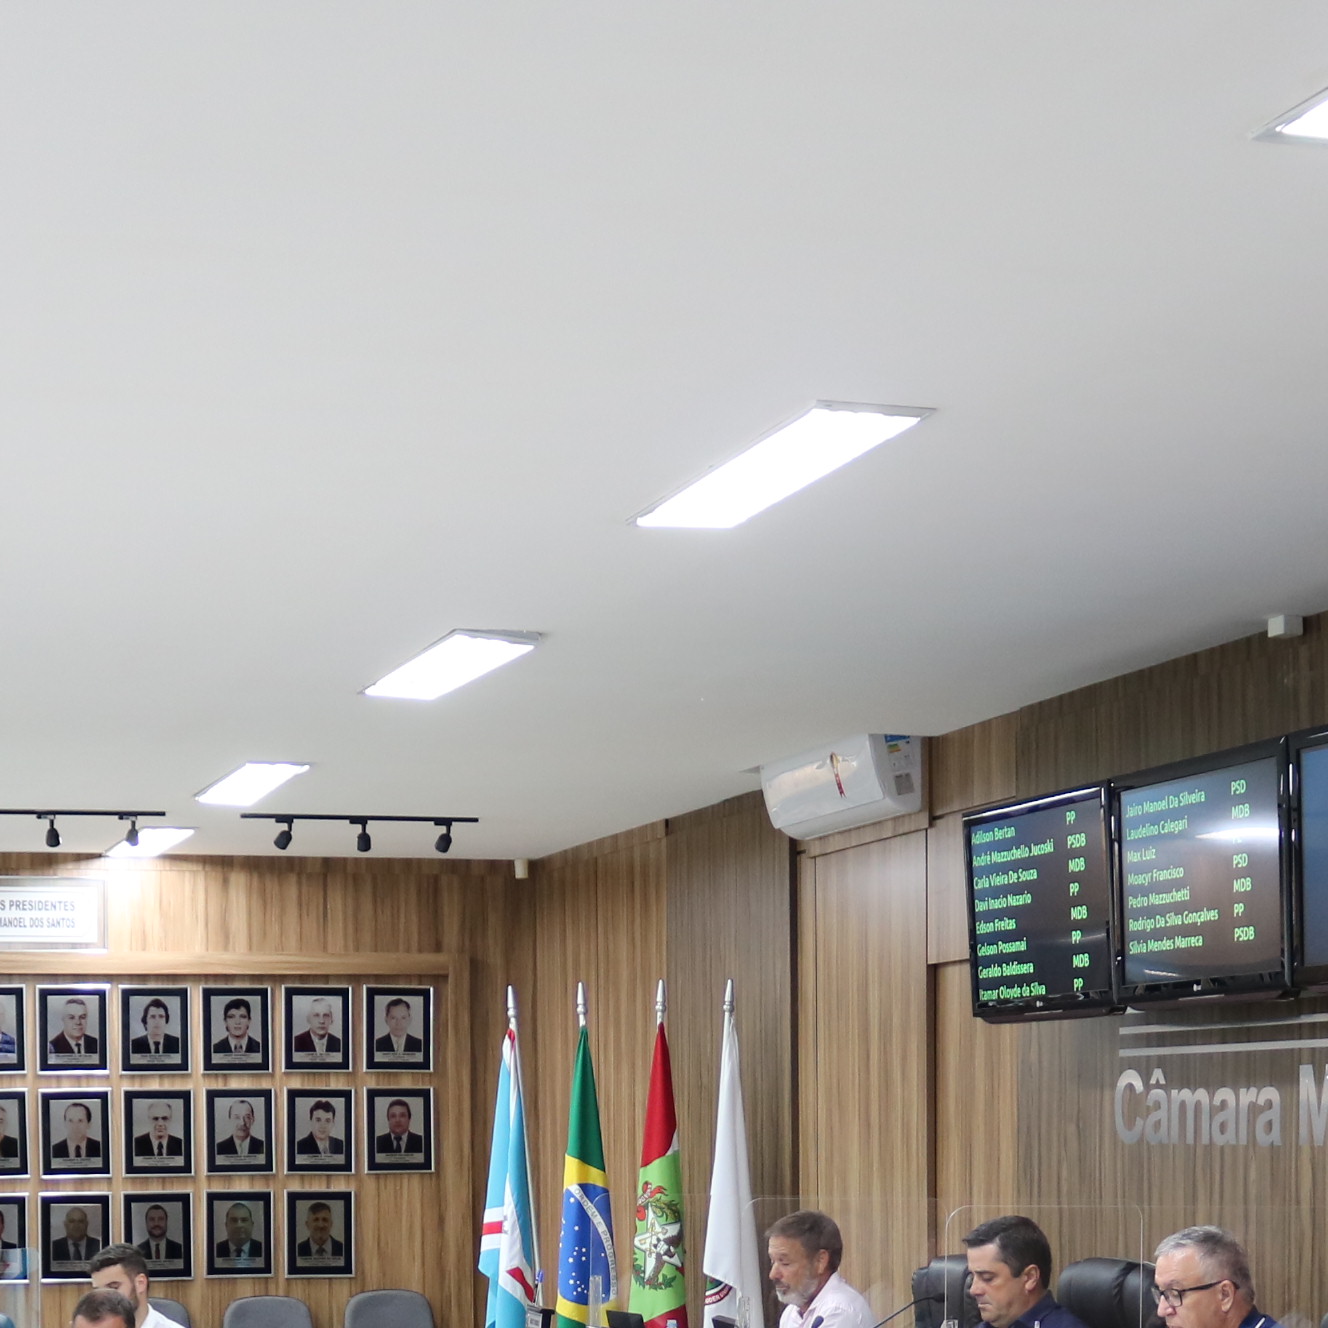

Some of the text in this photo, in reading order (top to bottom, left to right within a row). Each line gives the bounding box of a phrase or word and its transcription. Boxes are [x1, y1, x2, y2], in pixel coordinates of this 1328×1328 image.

[1126, 780, 1246, 818] Jairo Manoel Da Silveira PSD
[1066, 810, 1076, 825] PP
[1126, 803, 1250, 841] Laudelino Calegari MDB
[994, 825, 1016, 841] Bertan
[972, 832, 1086, 867] André Mazzuchello Jucoski PSDB
[1127, 846, 1156, 863] Max Luiz
[974, 857, 1086, 890] Carla Vieira De Souza MDB
[1128, 853, 1248, 886] Moacyr Francisco PSD
[9, 899, 76, 912] PRESIDENTES
[975, 896, 988, 912] Davi
[1007, 891, 1032, 907] Nazario
[1069, 882, 1080, 897] PP
[1128, 877, 1252, 909] Pedro Mazzuchetti MDB
[29, 916, 45, 929] DOS
[46, 916, 75, 929] SANTOS
[976, 905, 1088, 934] Edson Freitas MDB
[1129, 903, 1245, 932] Rodrigo Da Silva Gonçalves PP
[977, 930, 1082, 956] Gelson Possamai PP
[1129, 926, 1255, 955] Silvia Mendes Marreca PSDB
[978, 953, 1090, 979] Geraldo Baldissera MDB
[1022, 983, 1030, 996] da
[1030, 981, 1046, 996] Silva
[1073, 978, 1084, 992] PP
[1113, 1068, 1281, 1147] Câmara
